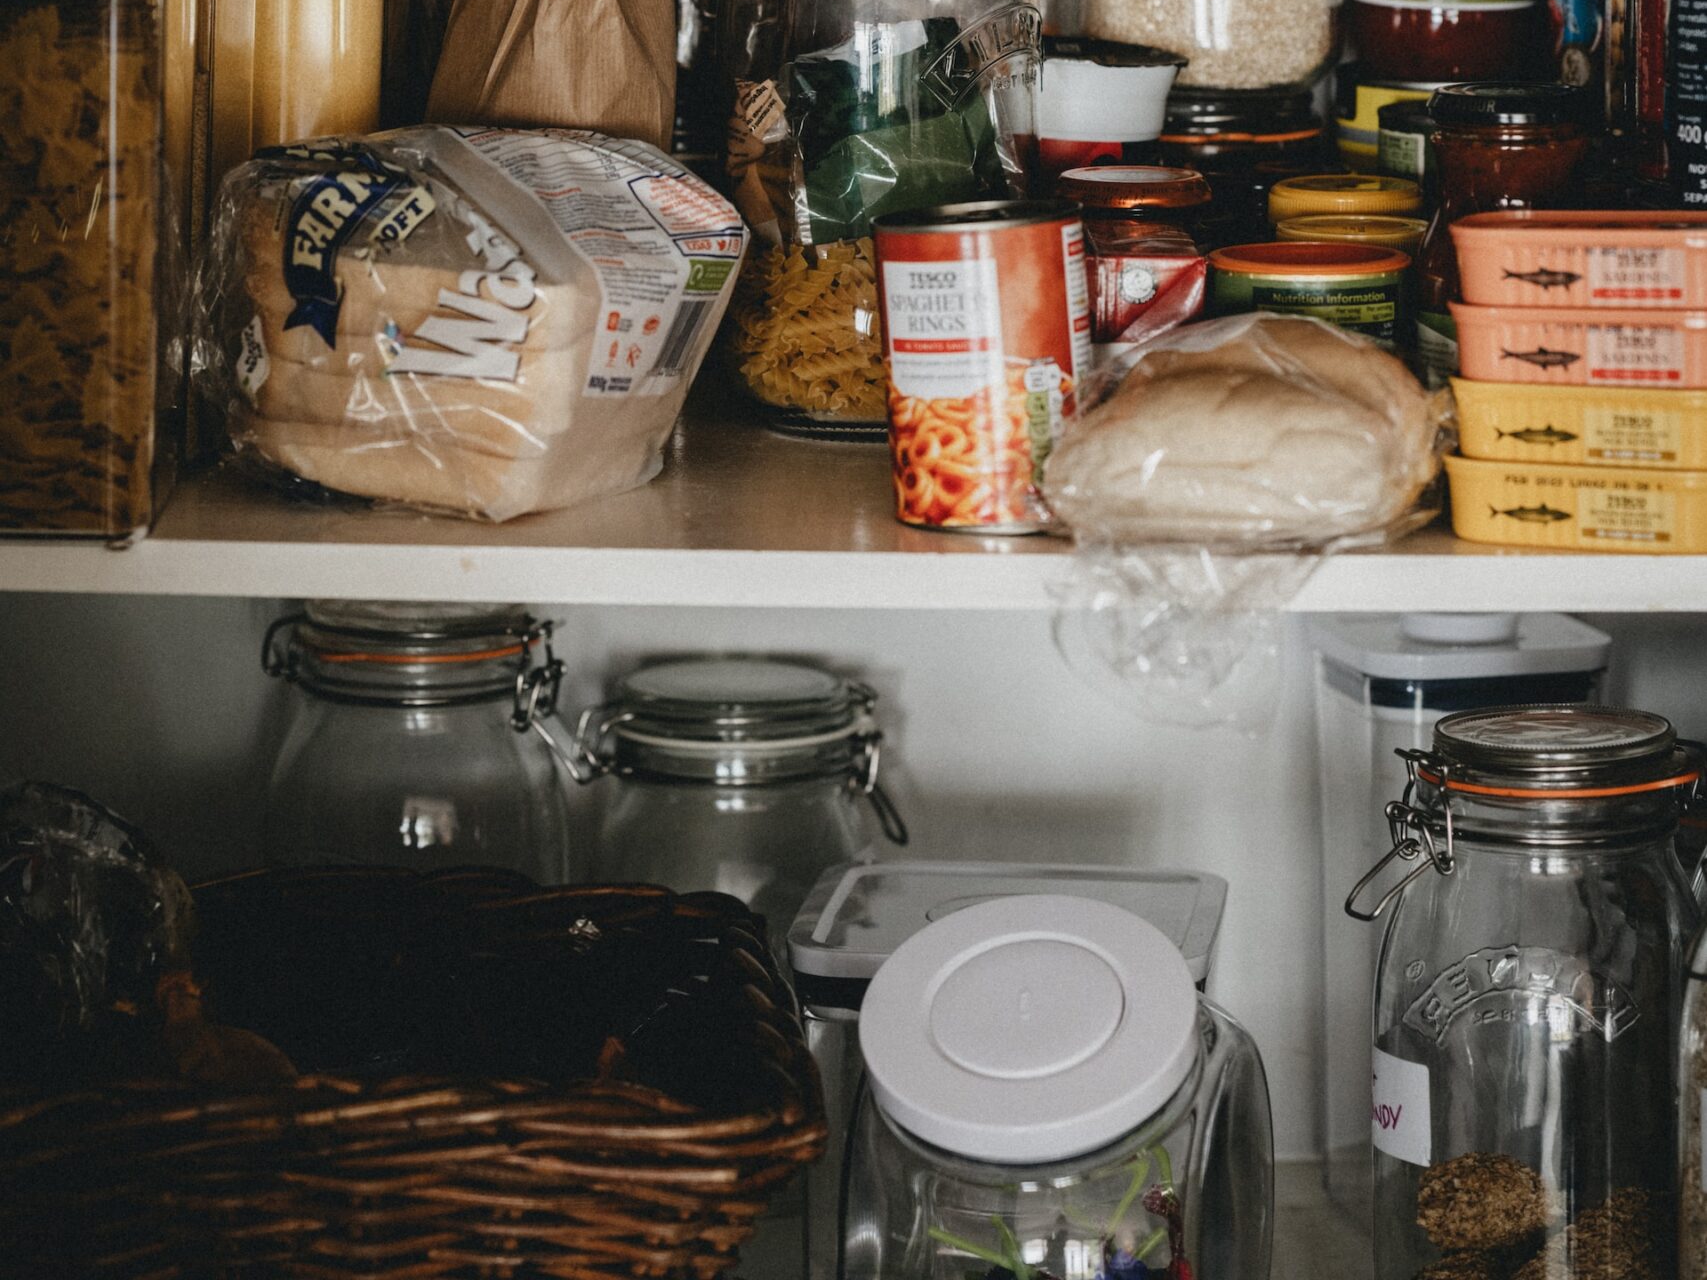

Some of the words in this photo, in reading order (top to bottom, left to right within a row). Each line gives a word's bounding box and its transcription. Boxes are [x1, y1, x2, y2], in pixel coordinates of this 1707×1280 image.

[1677, 124, 1702, 144] 400
[909, 271, 957, 283] TESCO
[890, 293, 980, 313] SPAGHETI
[1272, 292, 1324, 305] Nutrition
[1326, 291, 1386, 305] Information
[908, 315, 966, 332] RINGS
